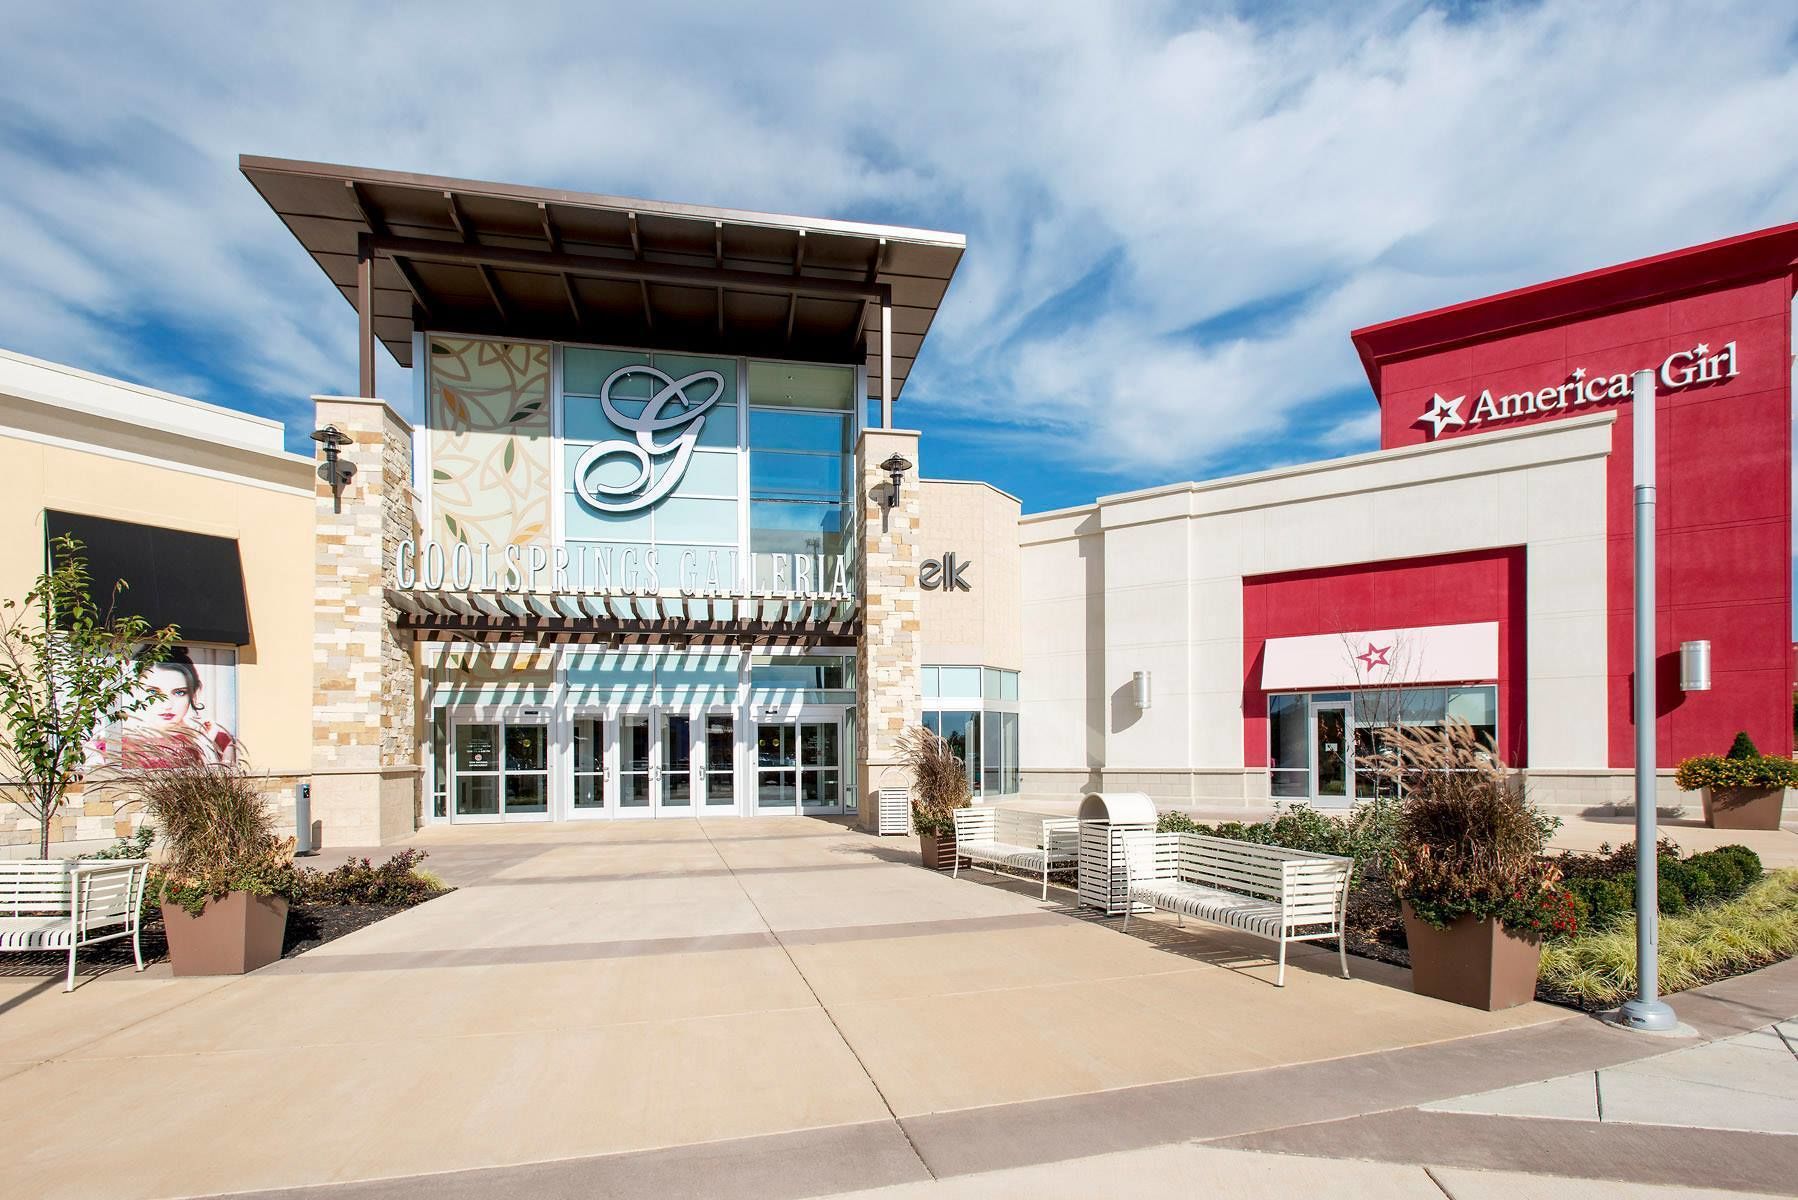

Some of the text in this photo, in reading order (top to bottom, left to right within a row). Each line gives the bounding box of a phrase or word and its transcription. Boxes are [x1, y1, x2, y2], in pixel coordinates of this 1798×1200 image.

[1469, 340, 1741, 425] America Girl
[396, 538, 850, 600] COOLSPRINGS GALLERIA
